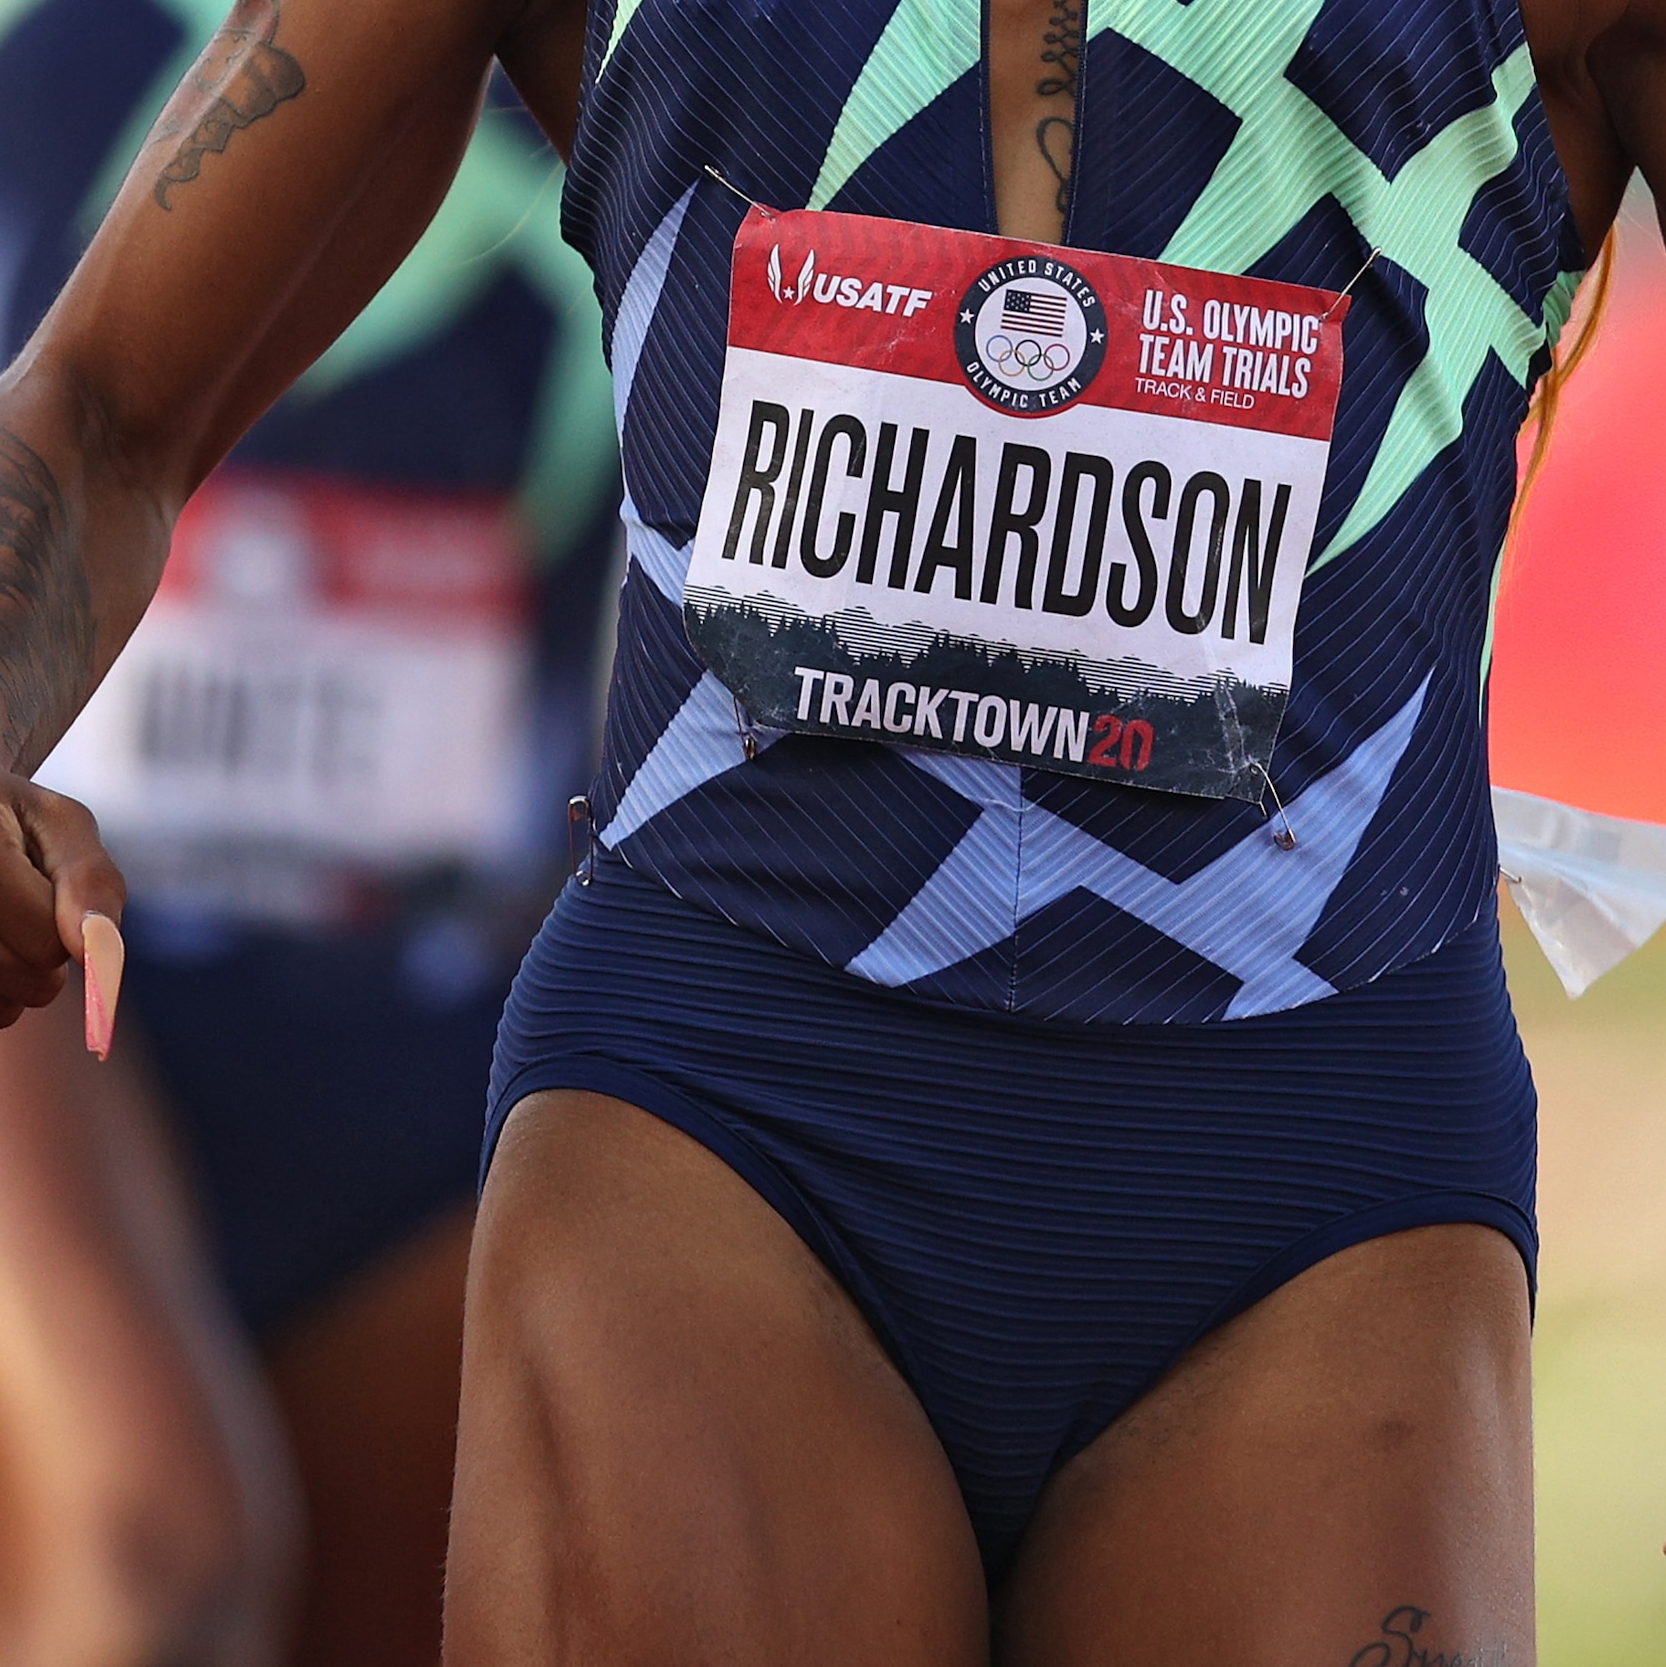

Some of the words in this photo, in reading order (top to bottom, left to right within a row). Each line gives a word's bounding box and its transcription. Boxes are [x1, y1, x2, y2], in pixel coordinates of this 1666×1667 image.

[813, 273, 933, 317] USATF
[978, 260, 1037, 292] UNITED
[1044, 262, 1096, 308] STATES
[1143, 289, 1194, 336] U.S.
[1203, 299, 1320, 355] OLYMPIC
[966, 361, 1030, 408] OLYMPIC
[1039, 377, 1082, 408] TEAM
[1139, 333, 1214, 384] TEAM
[1222, 345, 1312, 399] TRIALS
[1135, 377, 1192, 401] TRACK
[1194, 387, 1207, 403] &
[1210, 389, 1255, 410] FIELD
[721, 399, 1293, 645] RICHARDSON
